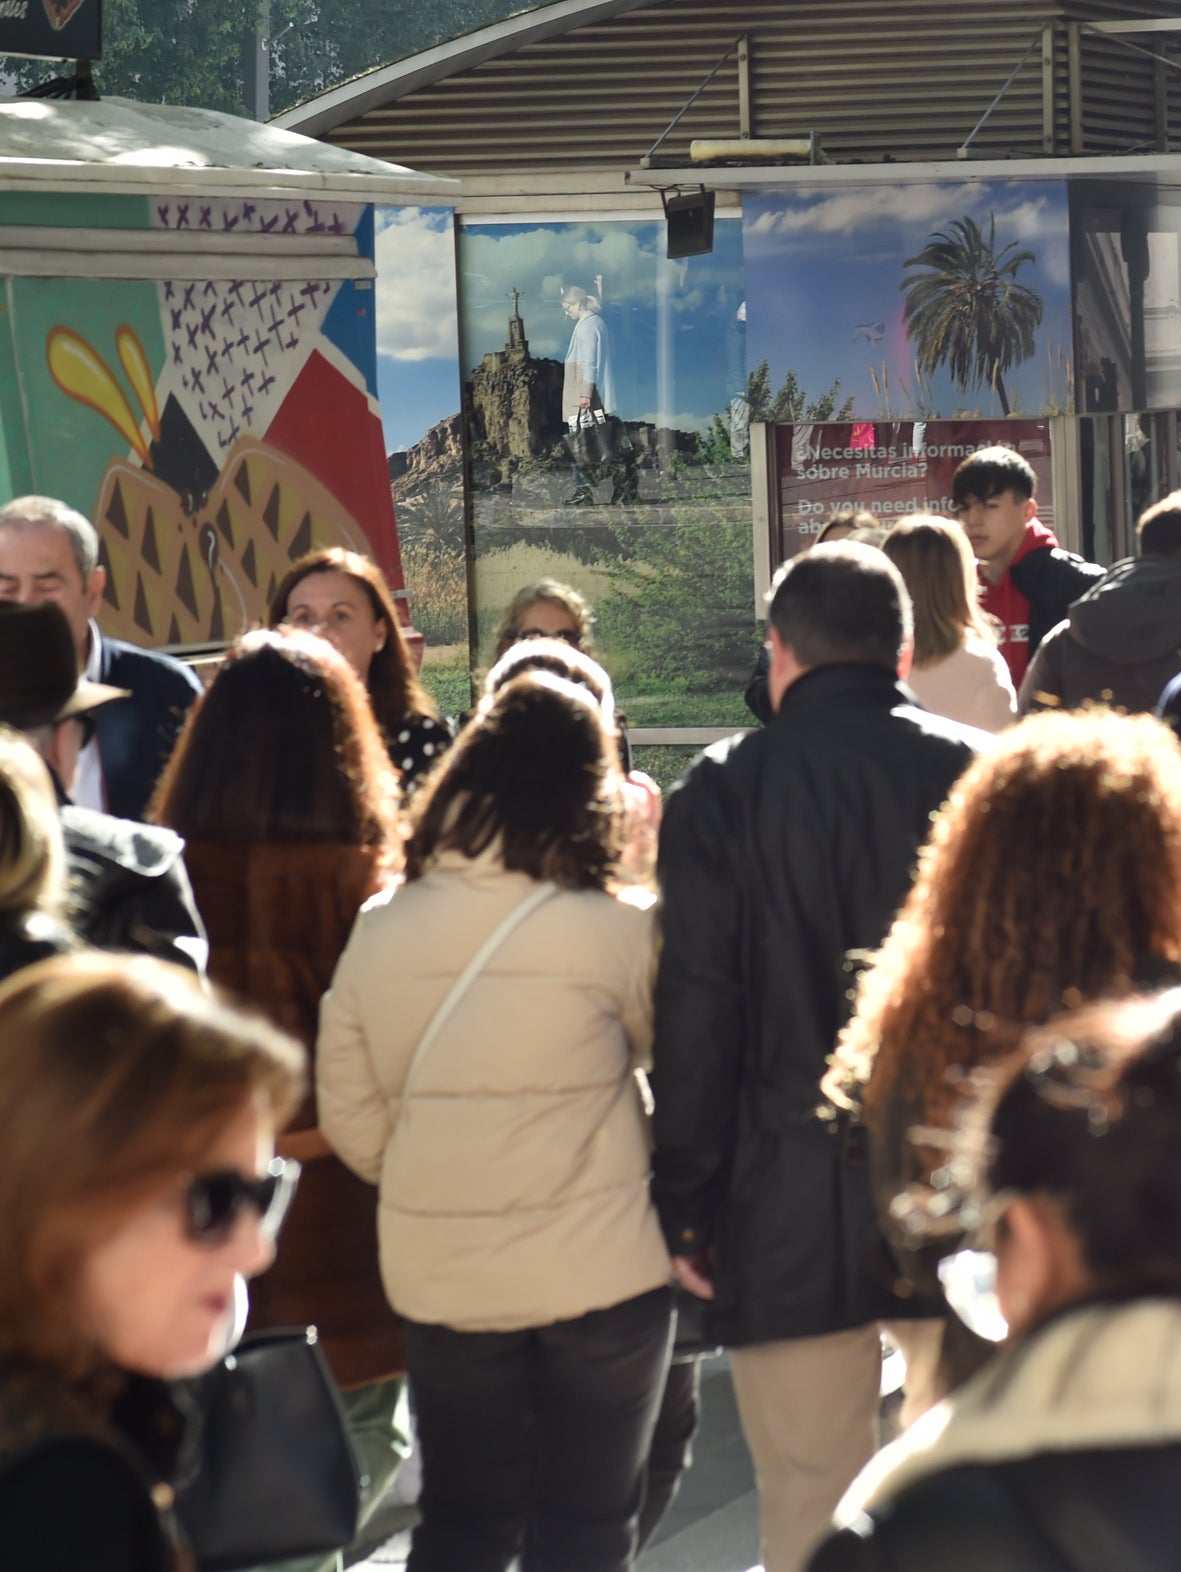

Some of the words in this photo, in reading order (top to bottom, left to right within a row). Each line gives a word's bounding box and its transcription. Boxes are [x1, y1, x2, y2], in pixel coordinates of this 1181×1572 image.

[796, 463, 851, 480] sobre
[855, 462, 929, 479] Murcia?
[798, 499, 825, 516] Do
[830, 501, 865, 514] you
[870, 497, 918, 514] need
